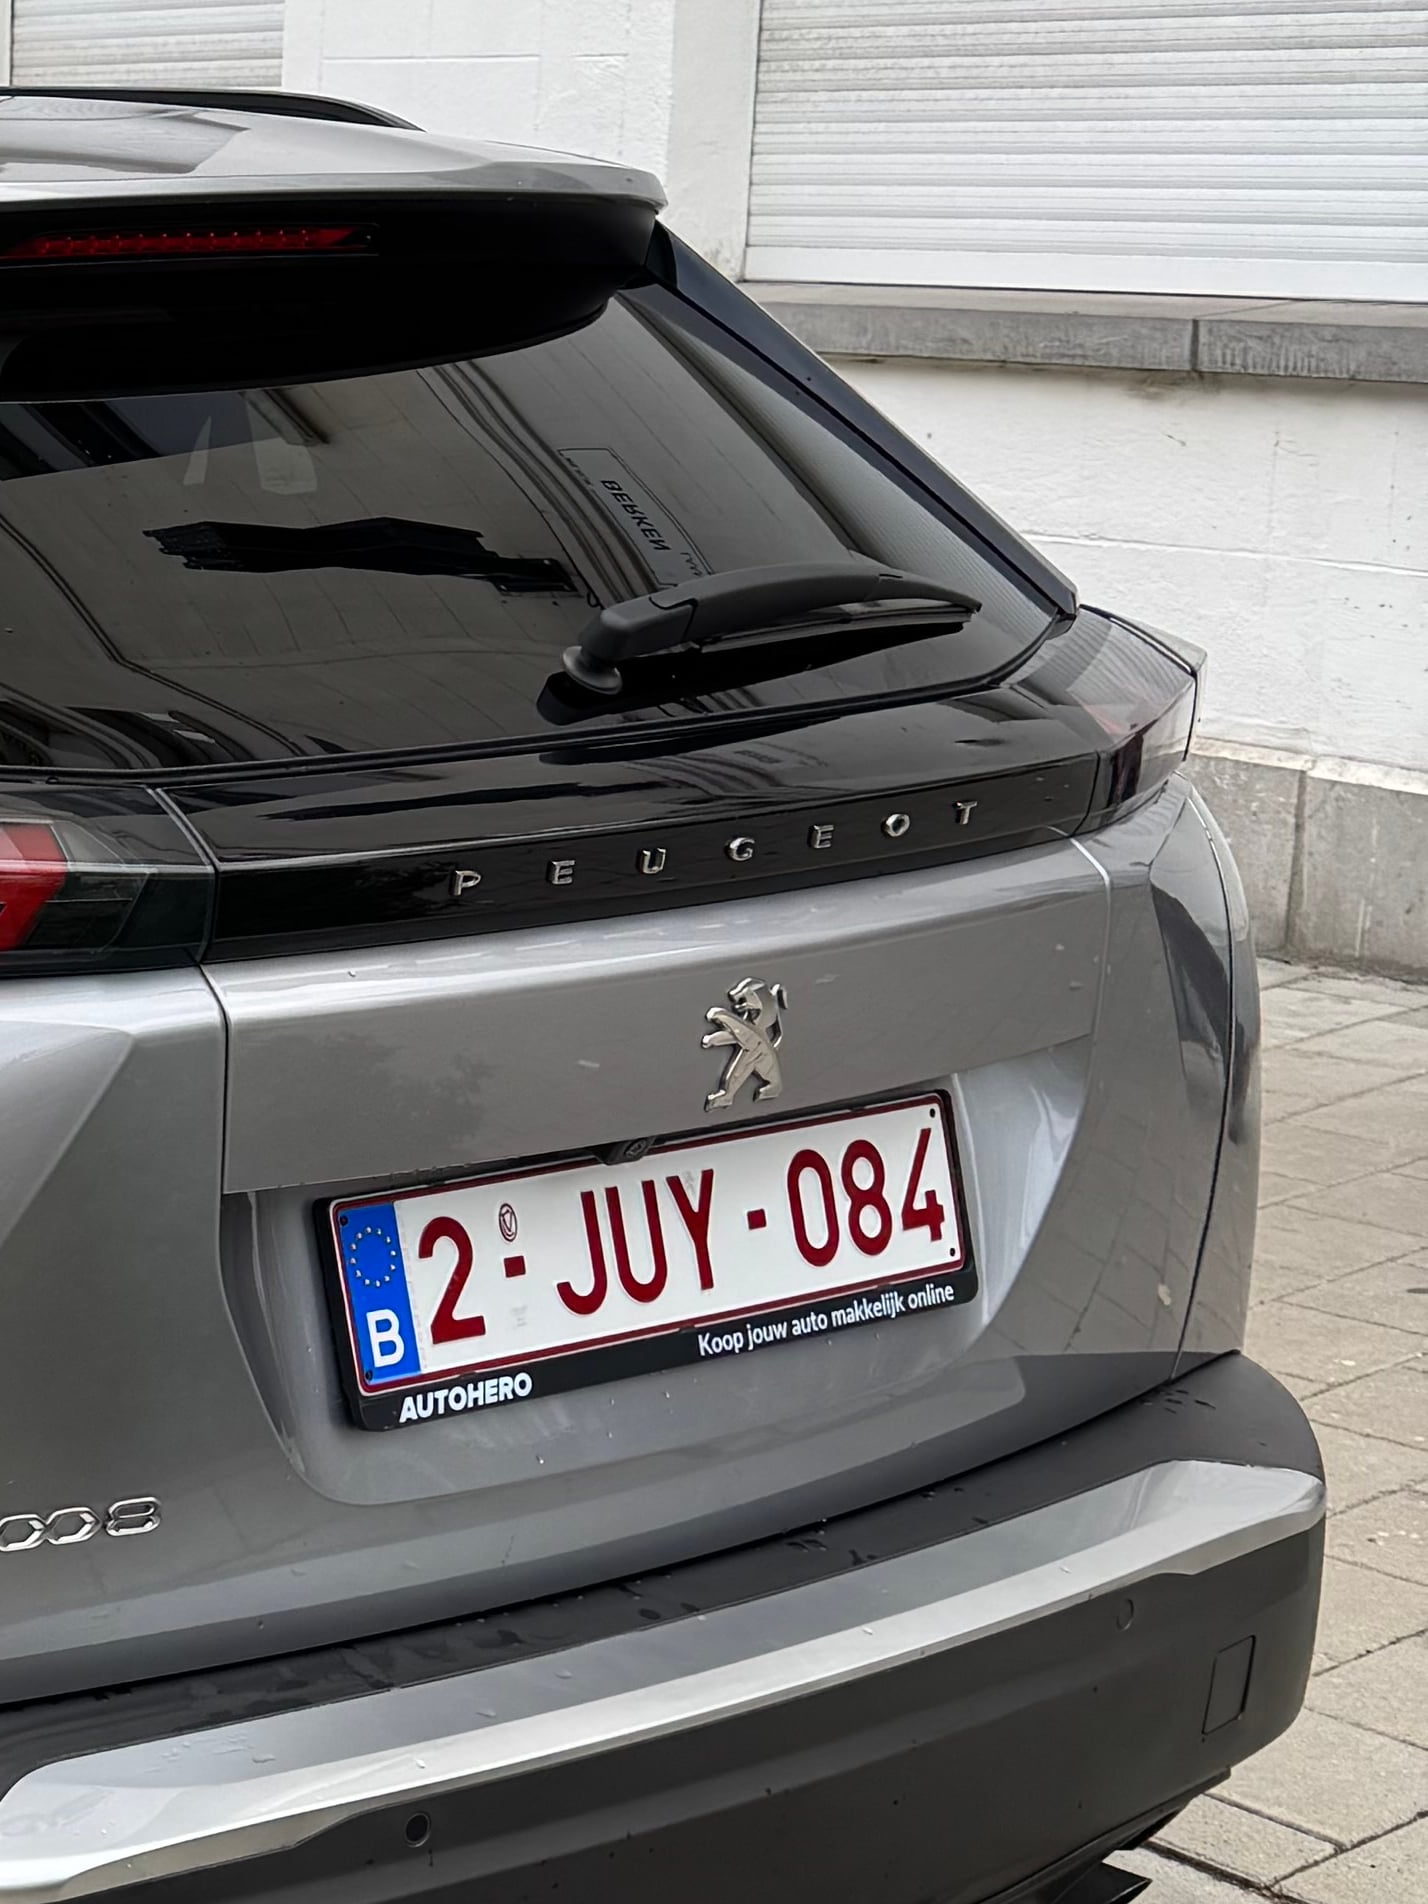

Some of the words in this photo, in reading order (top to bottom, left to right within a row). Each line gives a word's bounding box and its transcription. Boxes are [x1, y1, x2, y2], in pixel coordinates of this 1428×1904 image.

[452, 799, 980, 896] PEUGEOT
[366, 1308, 405, 1368] B
[697, 1331, 744, 1356] Koop
[746, 1320, 787, 1351] jouw
[791, 1312, 828, 1337] auto
[831, 1291, 906, 1327] makkelijk
[909, 1283, 955, 1310] online
[399, 1371, 533, 1424] AUTOHERO
